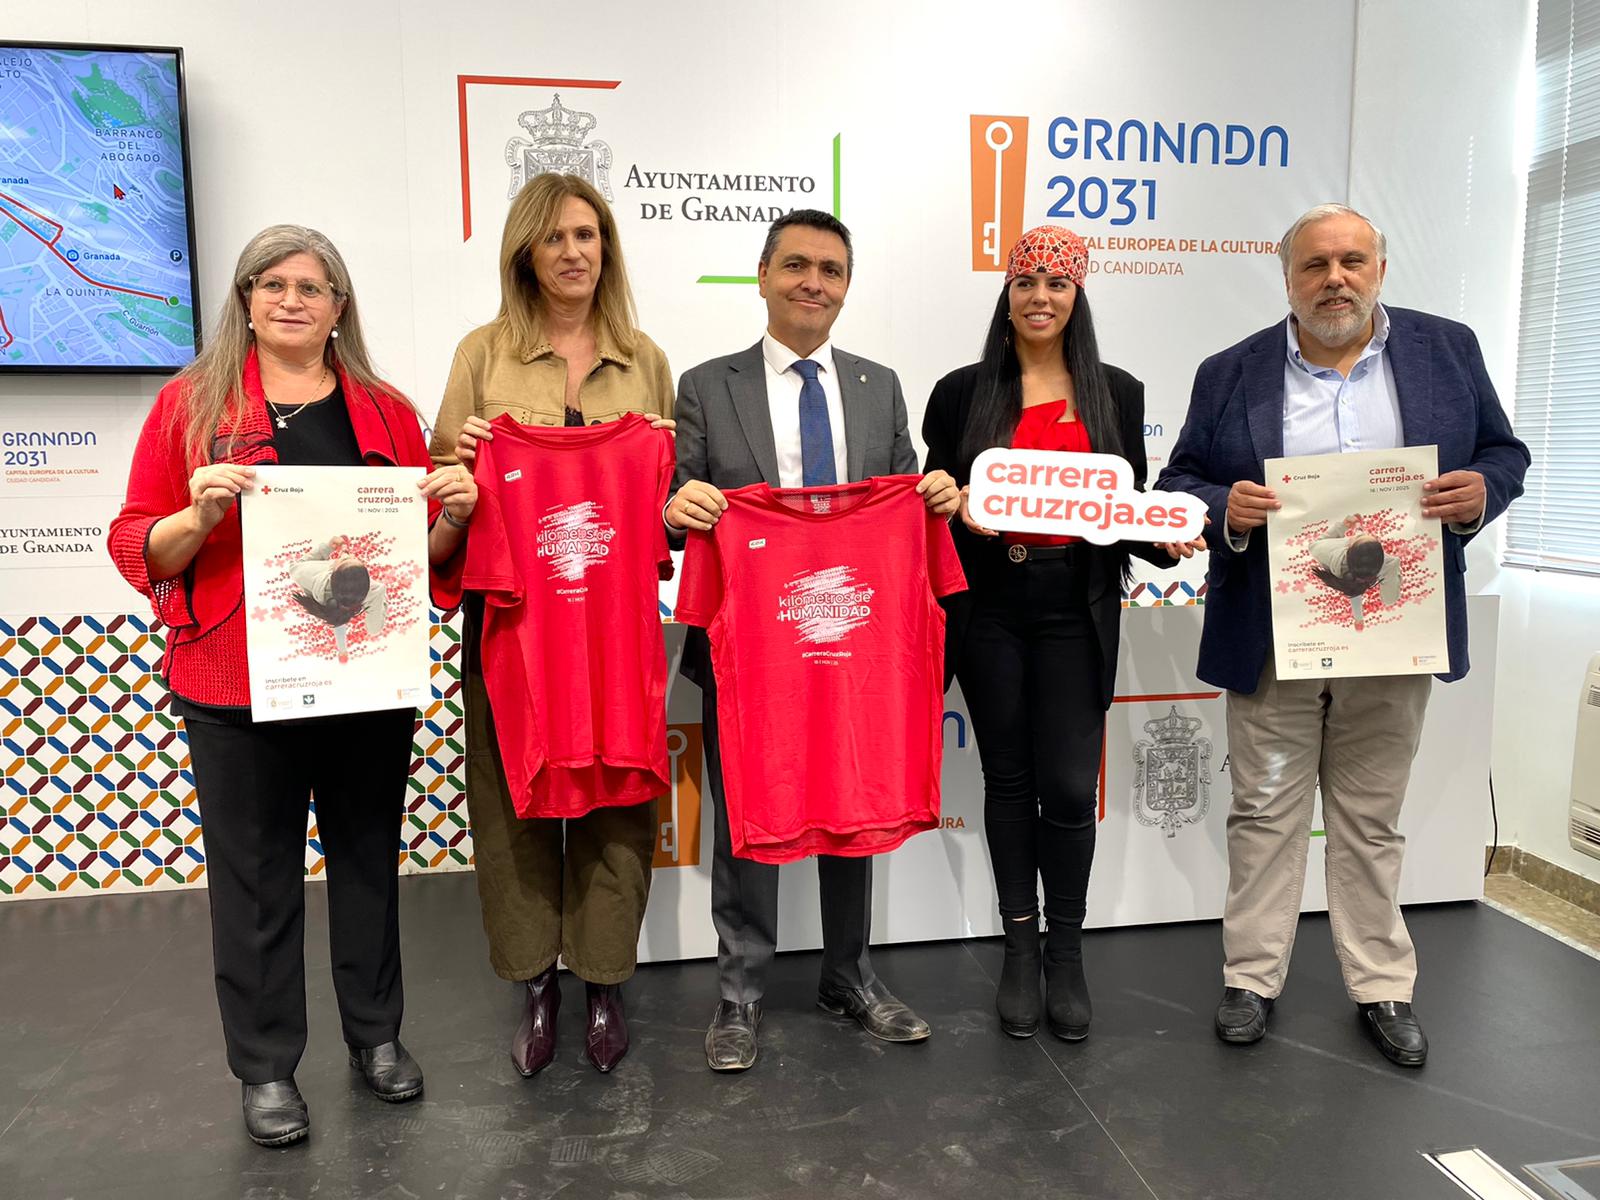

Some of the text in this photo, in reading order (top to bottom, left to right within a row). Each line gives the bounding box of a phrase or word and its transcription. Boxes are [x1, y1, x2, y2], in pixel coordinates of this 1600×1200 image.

[0, 57, 32, 67] LEJO
[95, 128, 163, 139] BARRANCO
[118, 141, 142, 150] DEL
[1047, 116, 1289, 167] GRANADA
[101, 153, 161, 163] ABOGADO
[624, 164, 815, 193] AYUNTAMIENTO
[1046, 175, 1157, 226] 2031
[640, 196, 794, 223] DE GRANAD
[1107, 237, 1176, 251] EUROPEA
[1179, 239, 1198, 252] DE
[1201, 239, 1218, 253] LA
[83, 252, 121, 260] Granada
[1103, 260, 1184, 276] CANDIDATA
[46, 288, 112, 297] LA QUINTA
[2, 431, 97, 447] GRANADA
[4, 451, 47, 467] 2031
[985, 462, 1118, 490] carrera
[1369, 466, 1406, 475] carrera
[1369, 473, 1425, 484] cruzroja.es
[357, 486, 395, 494] carrera
[357, 494, 414, 505] cruzroja.es
[983, 493, 1188, 530] cruzroja.es
[0, 527, 102, 538] YUNTAMIENTO
[23, 540, 93, 554] GRANADA
[853, 592, 871, 603] de
[780, 605, 871, 622] HUMANIDAD
